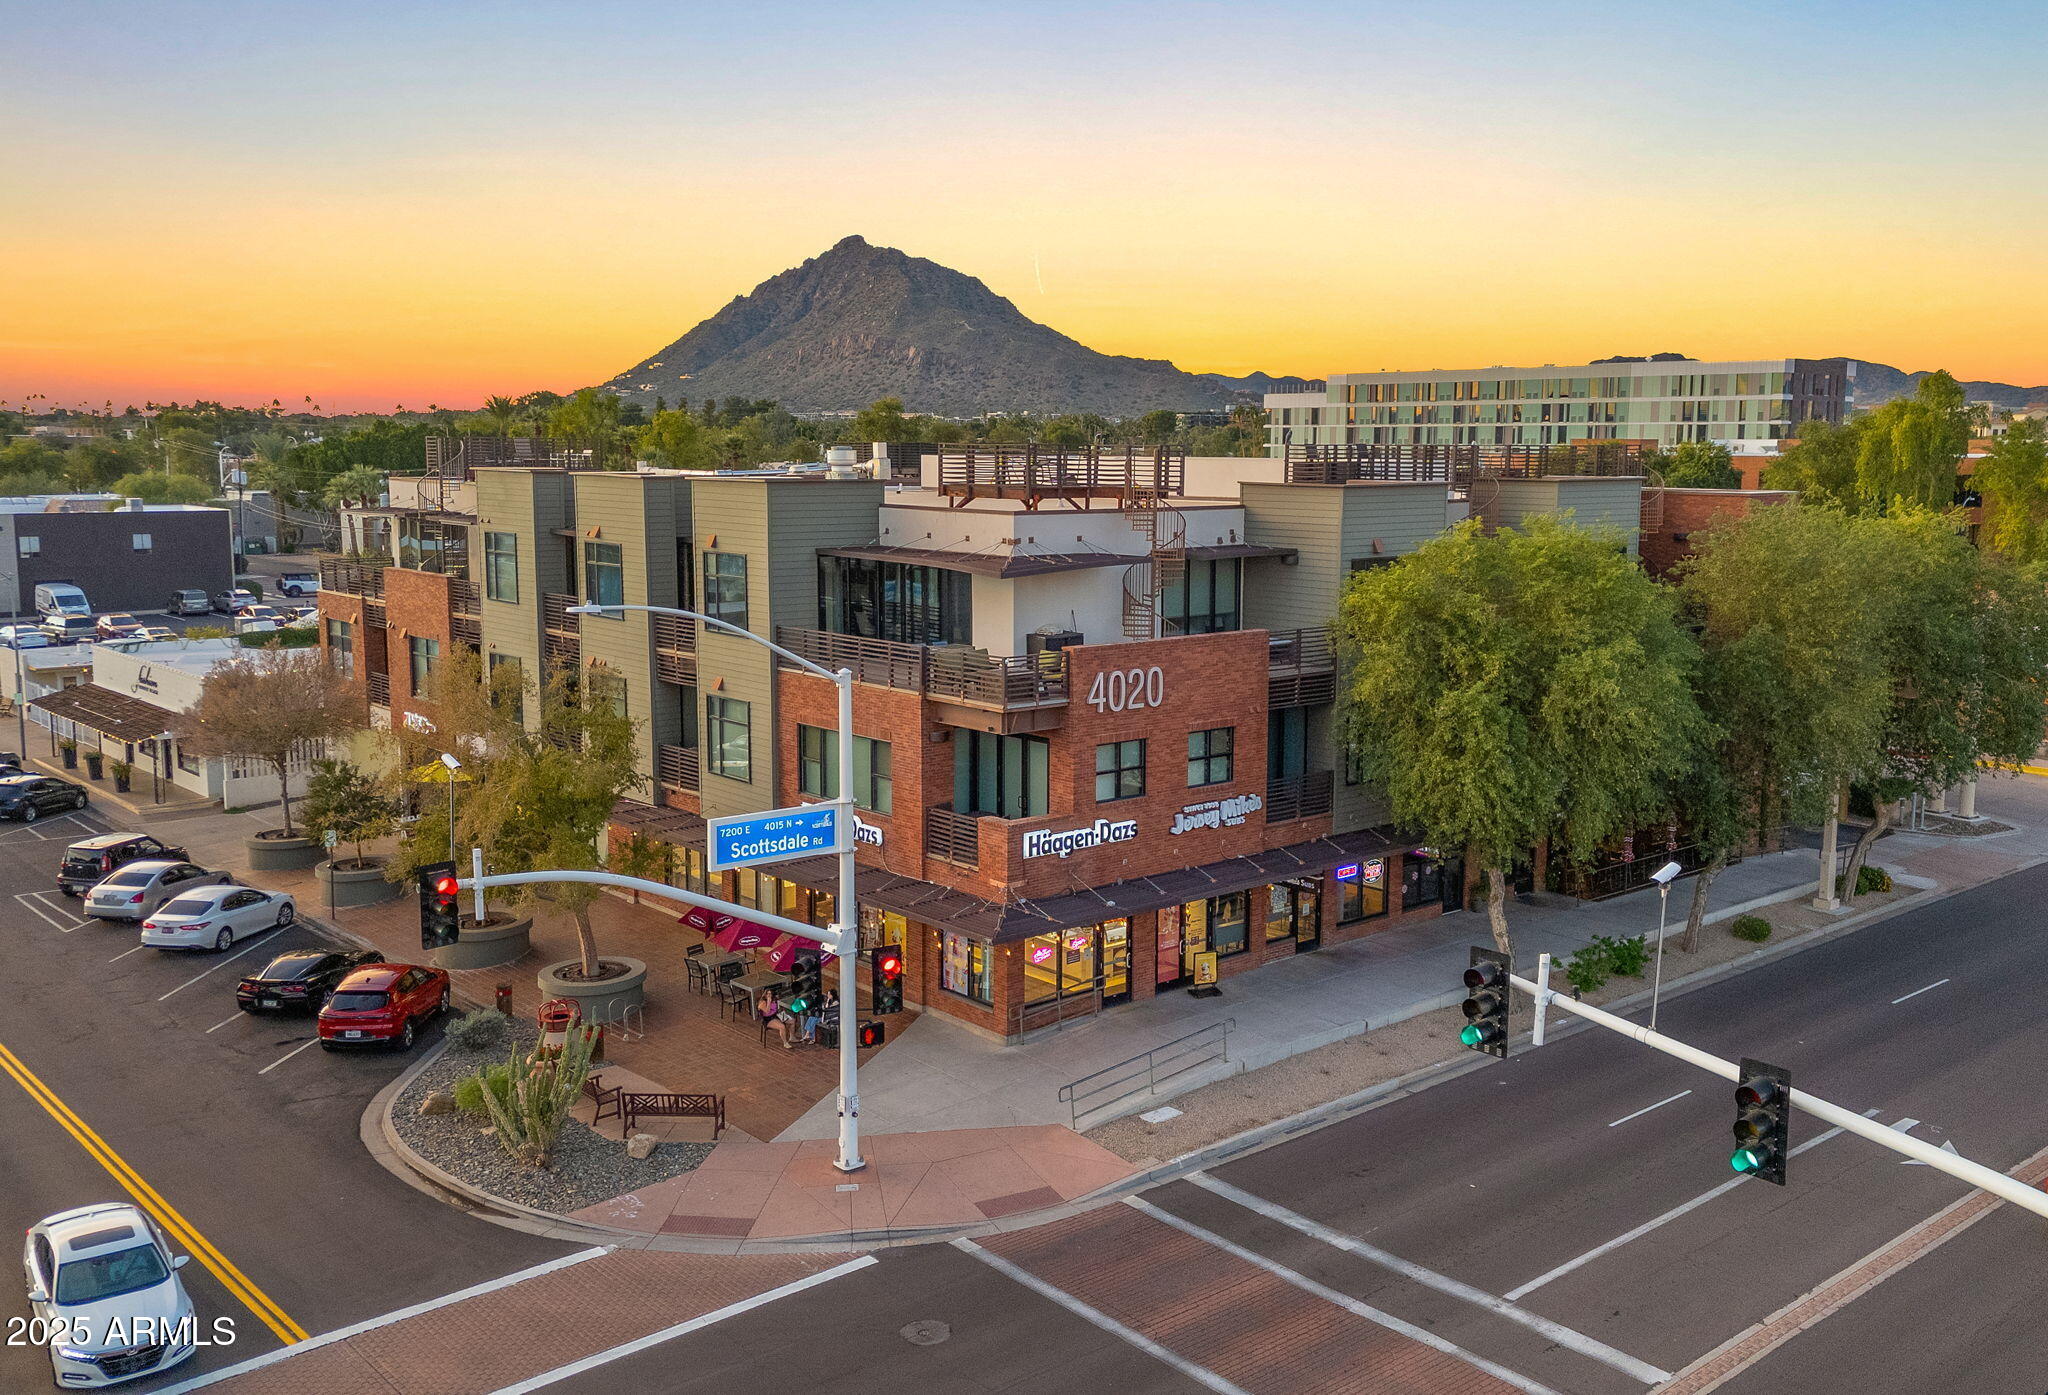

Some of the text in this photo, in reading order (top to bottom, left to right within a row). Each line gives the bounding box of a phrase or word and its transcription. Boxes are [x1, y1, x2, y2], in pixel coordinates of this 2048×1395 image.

[1087, 666, 1164, 713] 4020
[720, 825, 751, 838] 7200 E
[764, 819, 793, 831] 4015 N
[1169, 810, 1220, 835] Jersey
[730, 833, 823, 859] Scottsdale Rd
